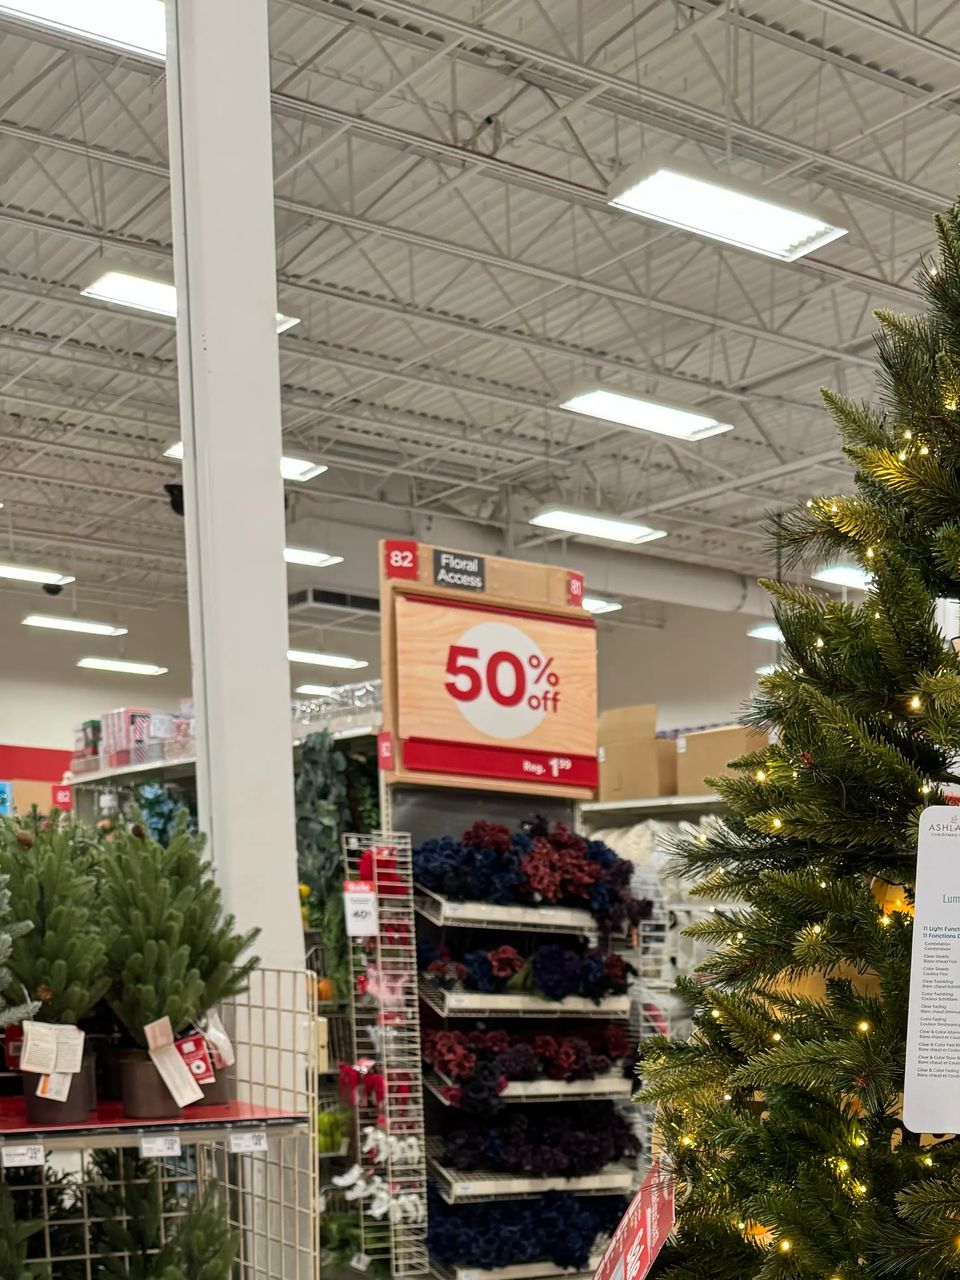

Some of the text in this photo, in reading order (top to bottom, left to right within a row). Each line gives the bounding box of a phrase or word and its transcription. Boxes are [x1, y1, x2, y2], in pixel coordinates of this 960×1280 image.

[390, 550, 414, 568] 82
[440, 554, 478, 572] Floral
[437, 568, 482, 587] Access
[528, 690, 561, 713] off
